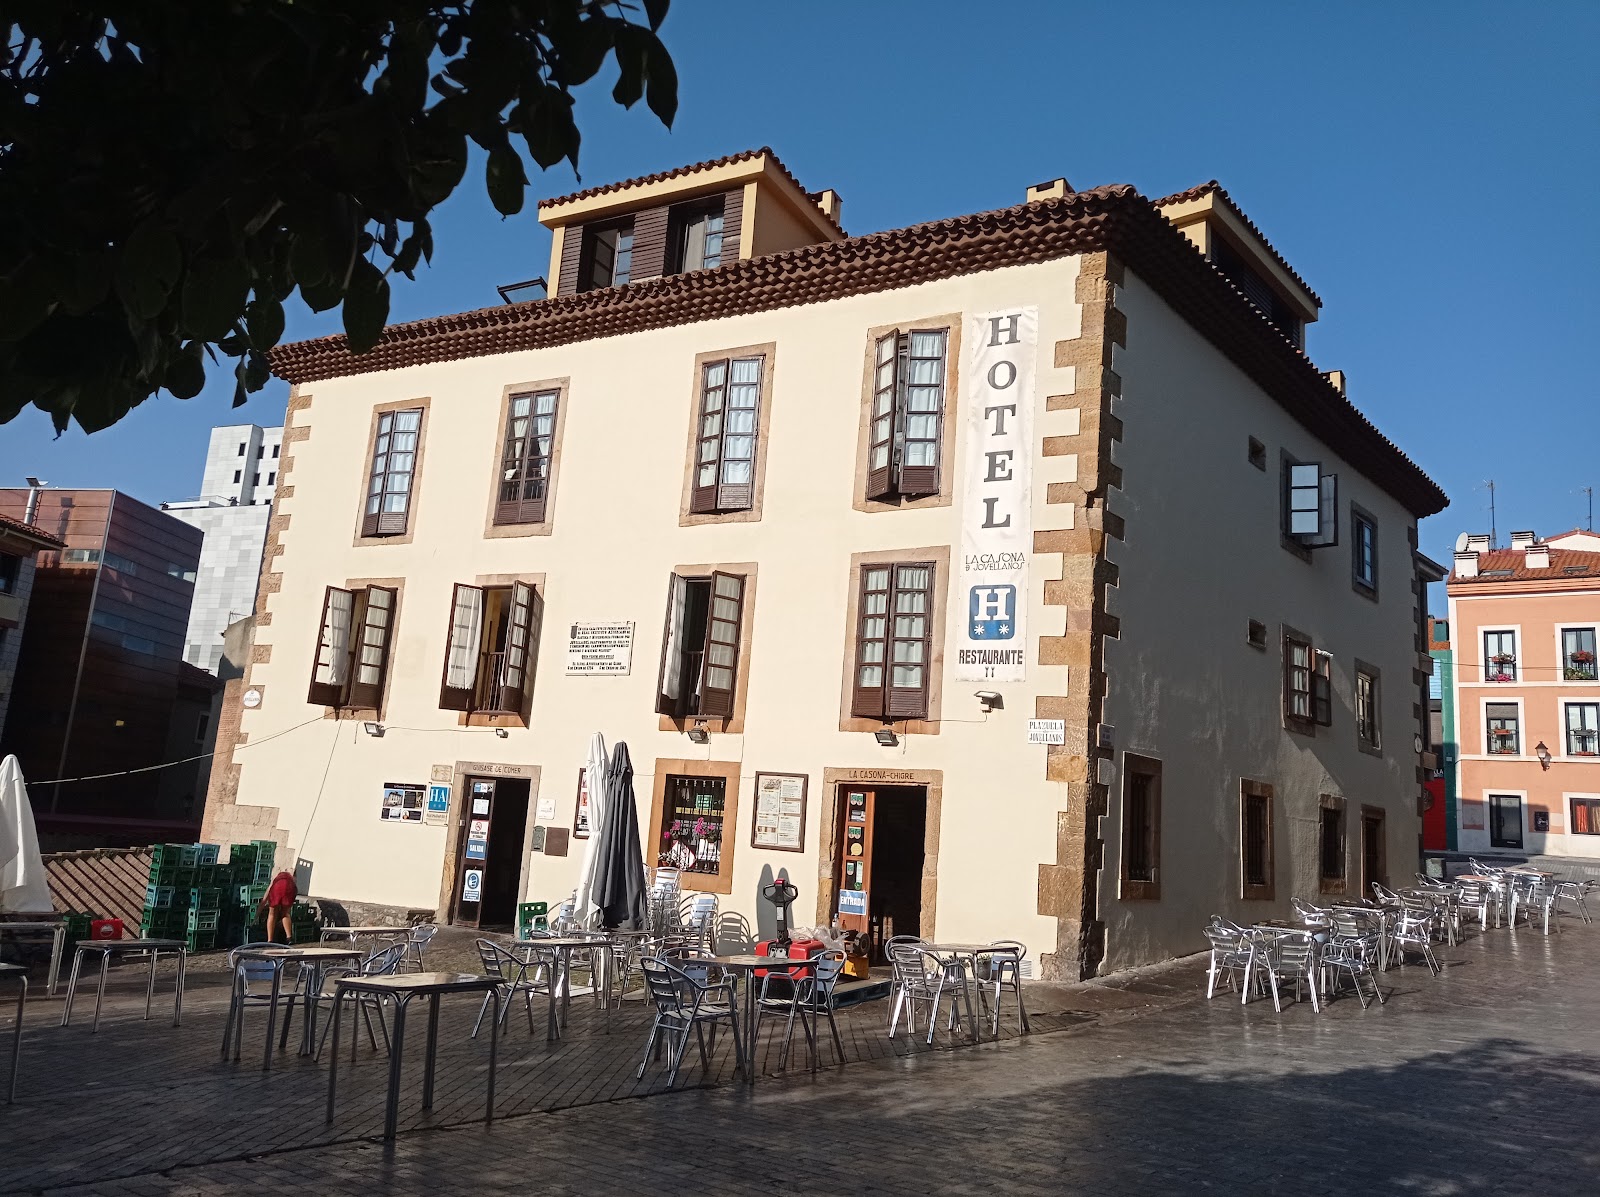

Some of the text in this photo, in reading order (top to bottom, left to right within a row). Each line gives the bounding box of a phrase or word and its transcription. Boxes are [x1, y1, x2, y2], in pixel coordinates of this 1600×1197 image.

[981, 313, 1022, 529] HOTEL
[965, 552, 1026, 565] LA CASONA
[973, 562, 1025, 571] JOVELLANOS
[973, 587, 1011, 621] H
[958, 649, 1024, 665] RESTAURANTE
[1029, 721, 1063, 730] PLAZUELA
[1028, 733, 1063, 742] JOVELLANOS
[848, 770, 858, 779] LA
[429, 788, 446, 803] HA
[840, 896, 865, 907] ENTRADA
